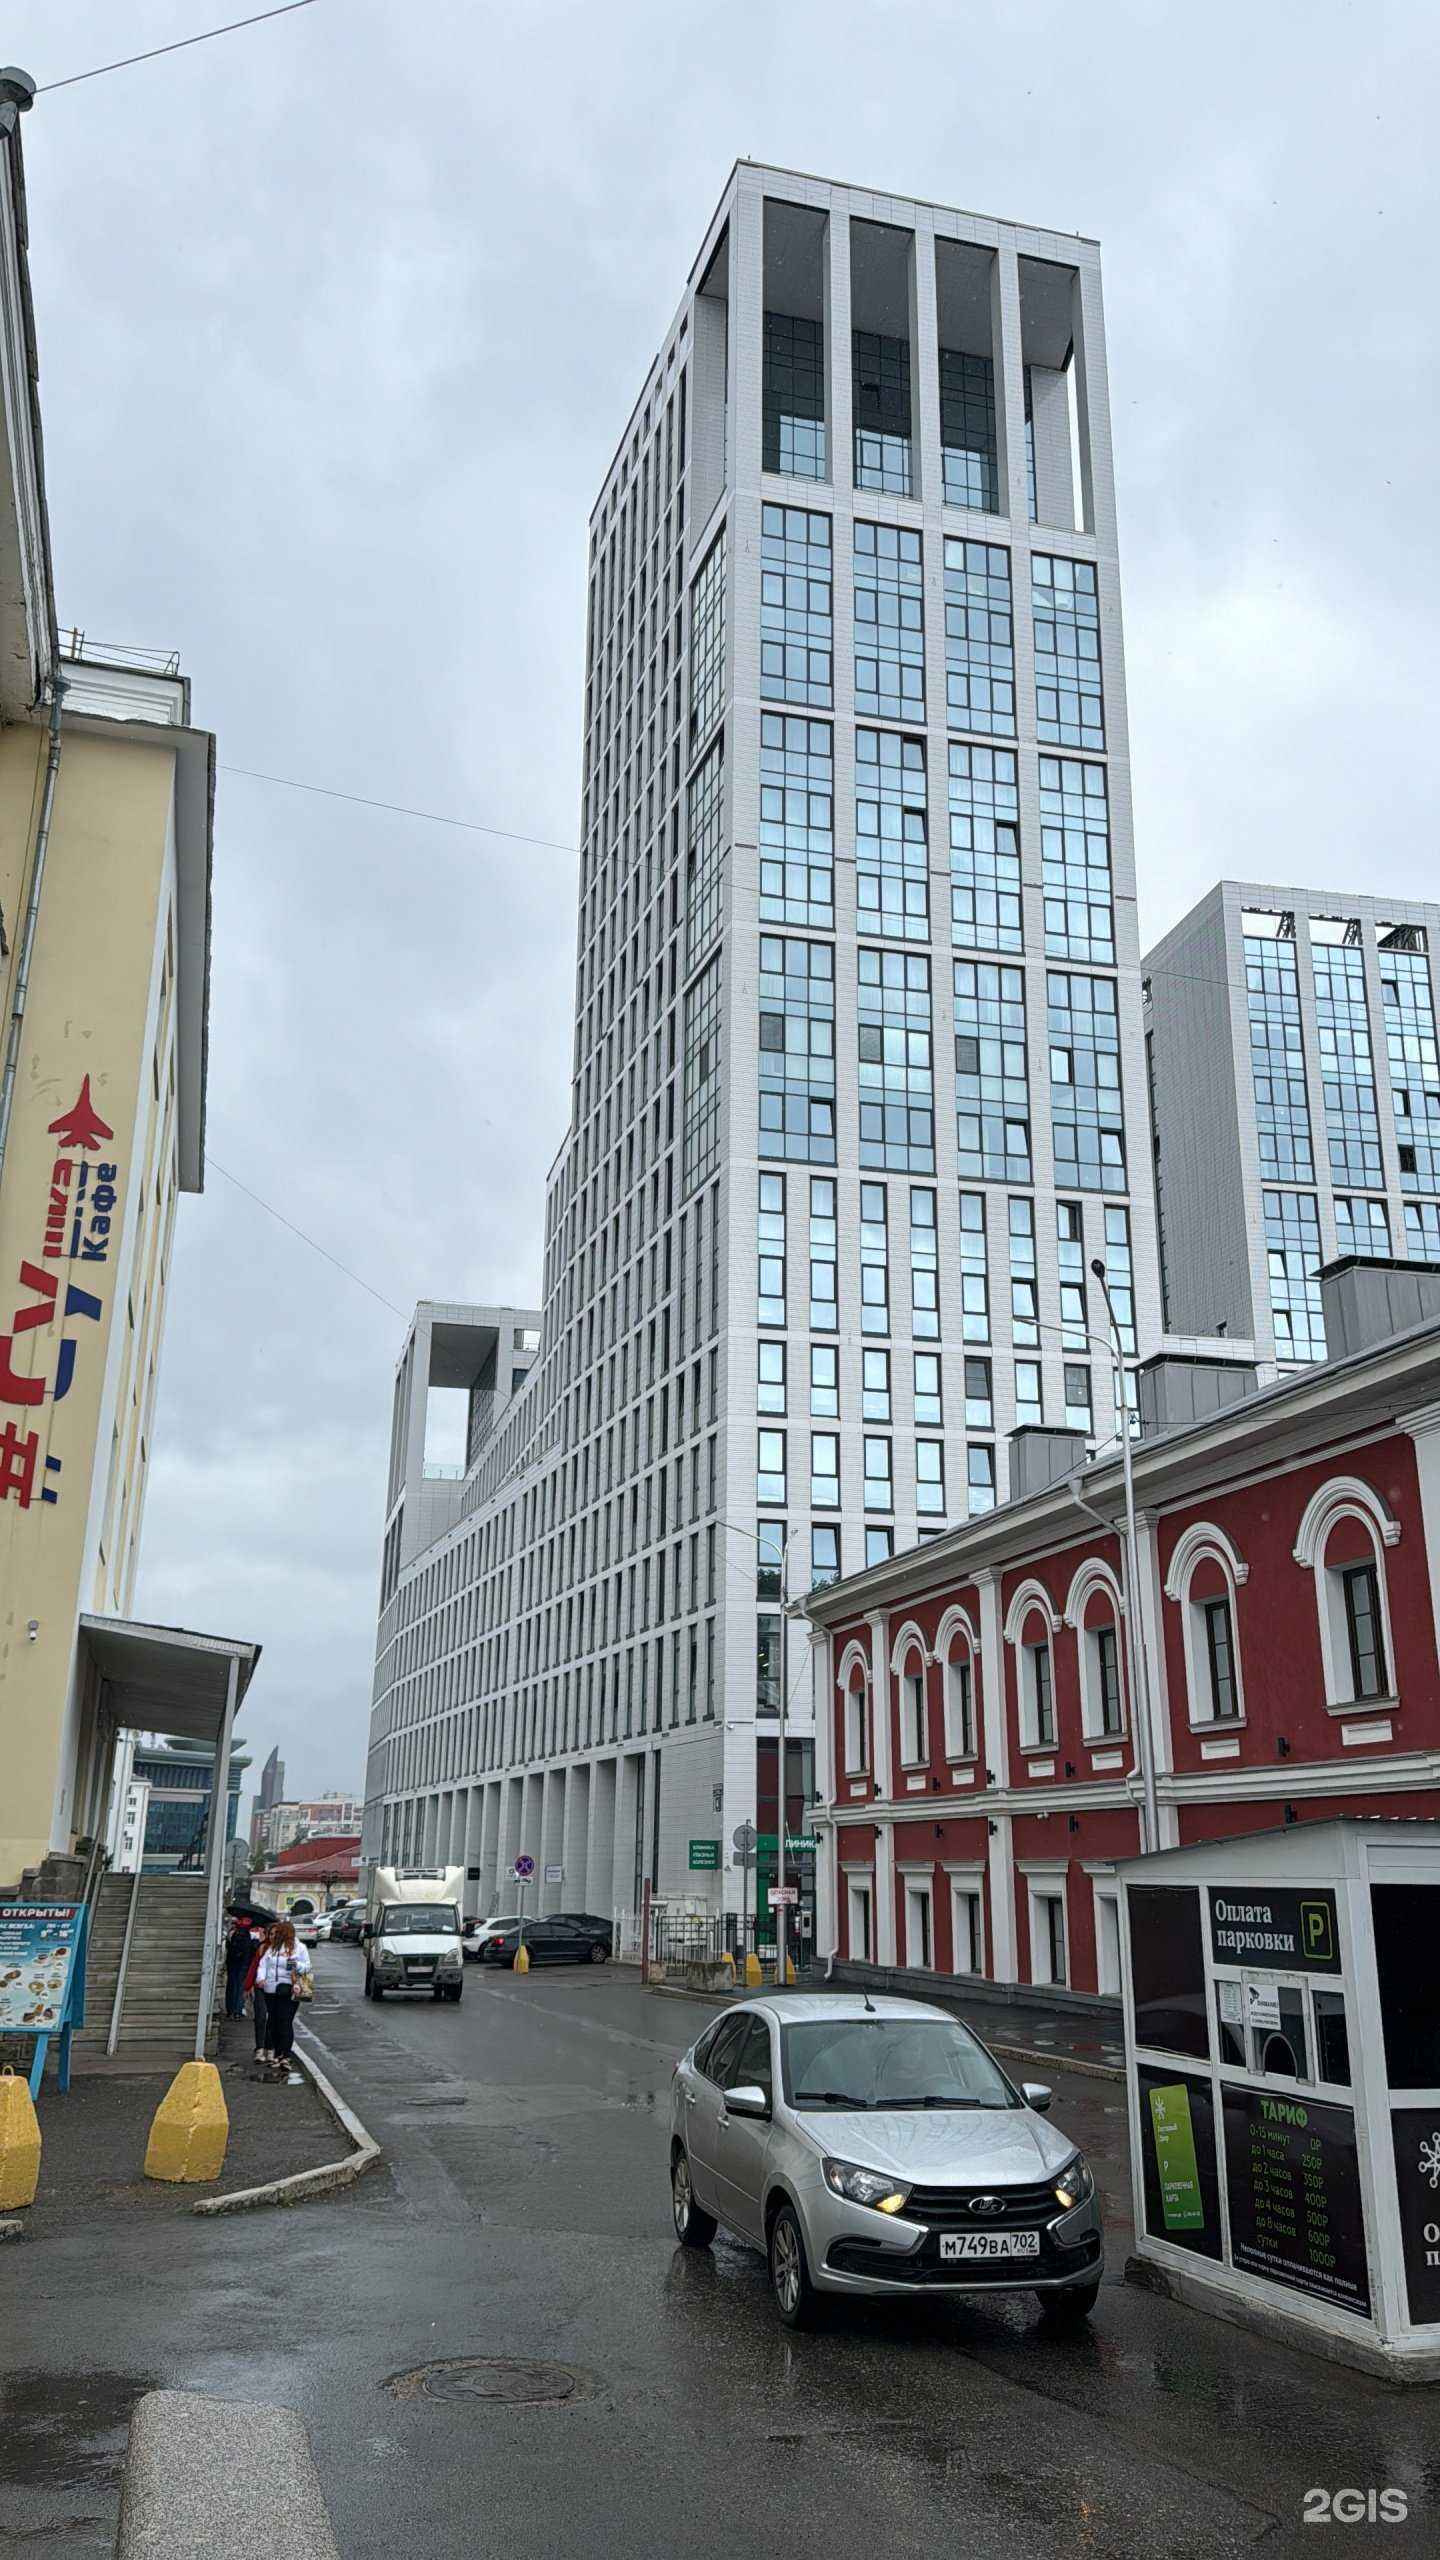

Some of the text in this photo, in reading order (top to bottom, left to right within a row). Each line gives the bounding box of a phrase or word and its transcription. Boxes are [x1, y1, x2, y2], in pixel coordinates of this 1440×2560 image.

[1215, 1899, 1272, 1923] Оплата
[1217, 1930, 1295, 1954] парковки
[1260, 2099, 1308, 2128] ТАРИФ
[1267, 2131, 1290, 2147] минут
[1269, 2167, 1292, 2181] часов
[1270, 2185, 1293, 2199] часов
[1272, 2204, 1295, 2218] часов
[1273, 2221, 1296, 2237] часов
[945, 2234, 1036, 2255] М749ВА 702
